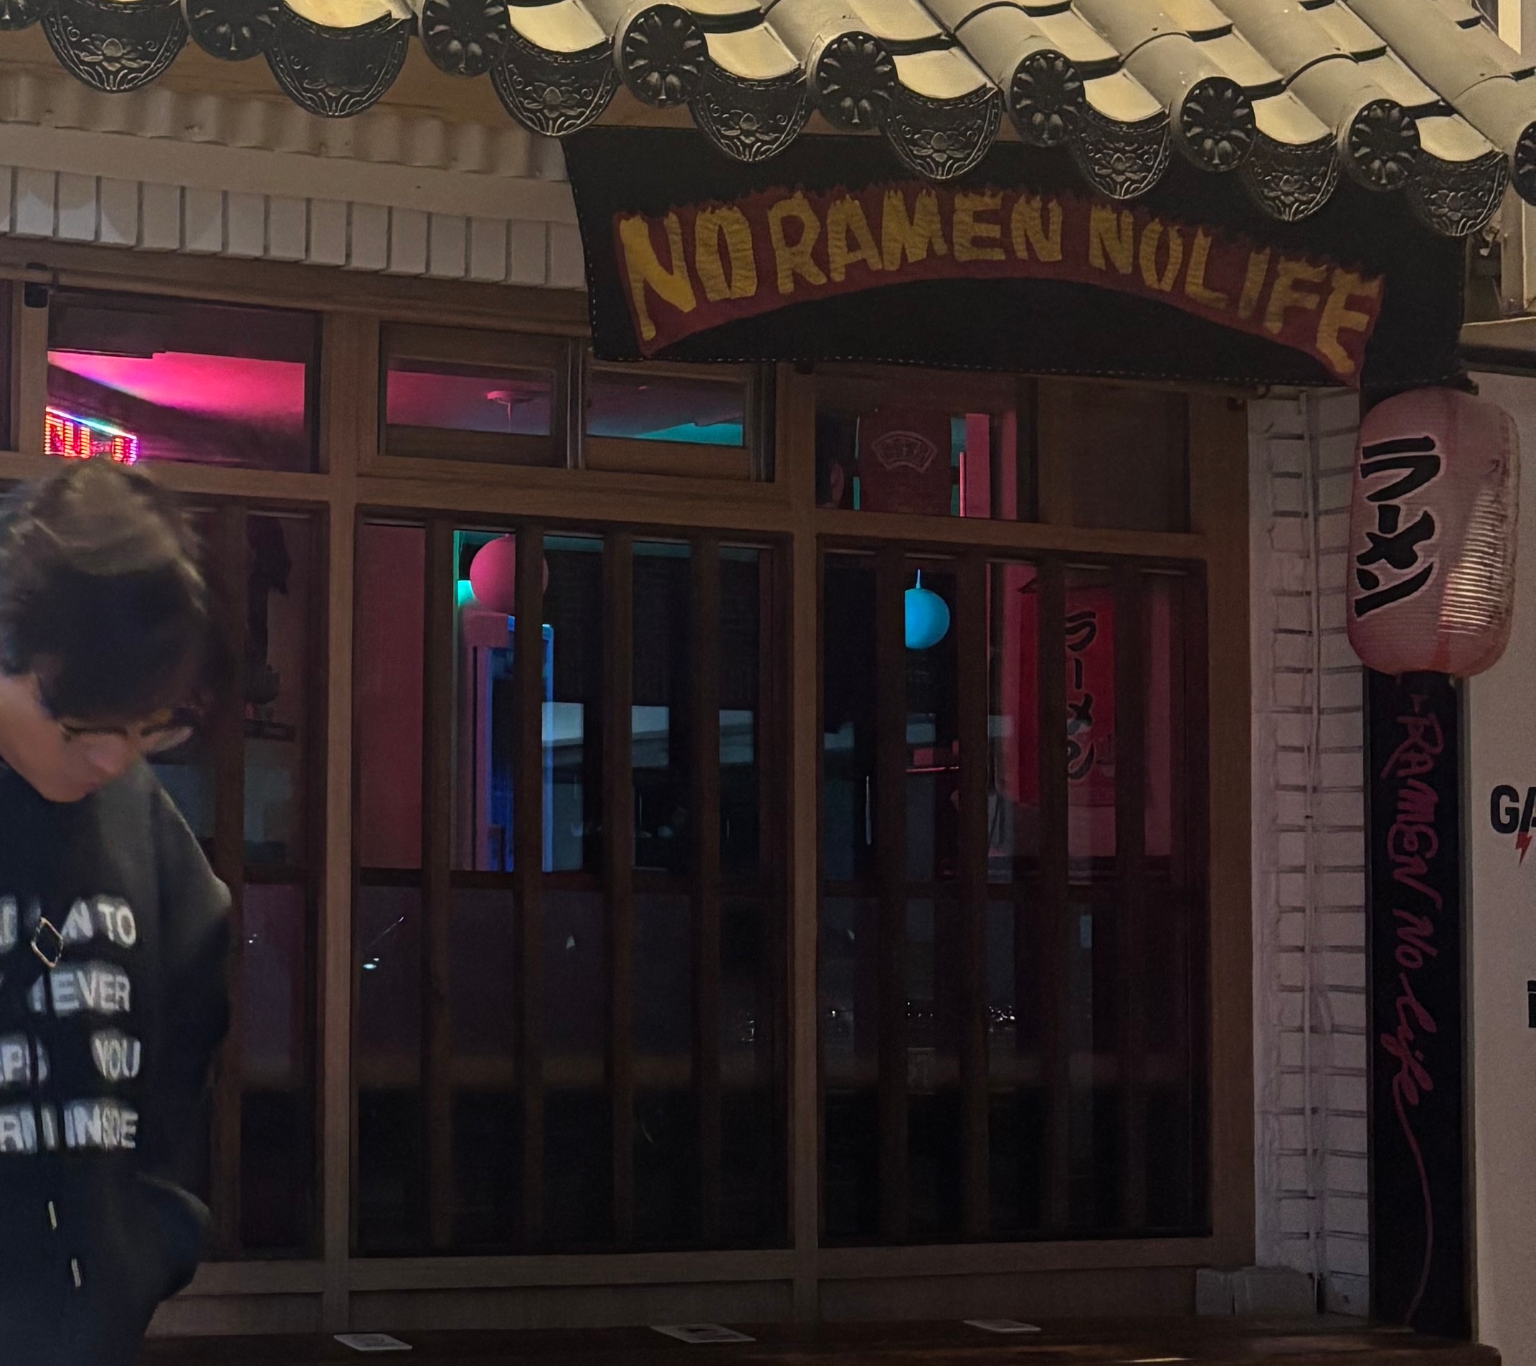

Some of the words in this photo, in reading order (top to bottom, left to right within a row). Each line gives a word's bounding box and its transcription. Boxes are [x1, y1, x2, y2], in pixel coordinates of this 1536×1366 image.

[619, 205, 758, 341] NO
[767, 188, 1064, 295] RAMEN
[1087, 203, 1184, 292] NO
[1185, 225, 1386, 375] LIFE
[1354, 434, 1441, 619] ラーメン
[1379, 709, 1444, 911] RAMEN
[96, 902, 137, 948] TO
[93, 1039, 141, 1079] YOU
